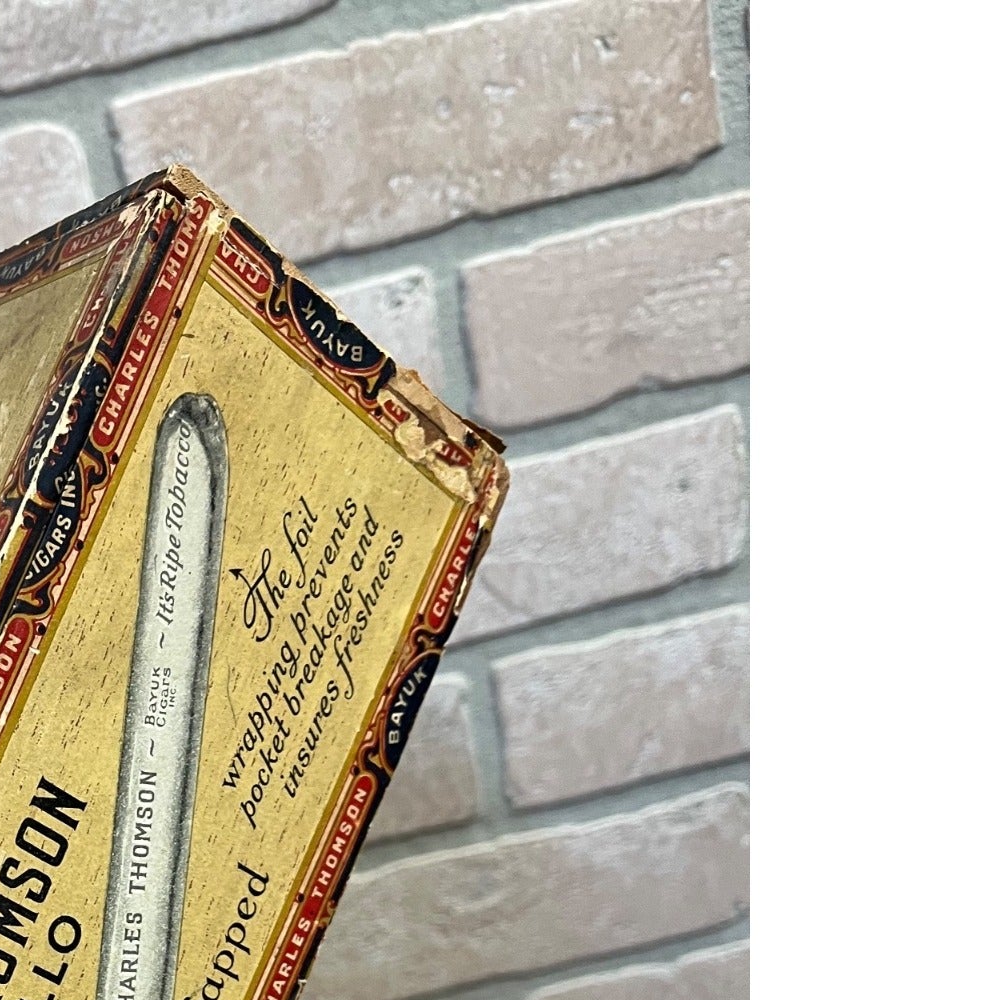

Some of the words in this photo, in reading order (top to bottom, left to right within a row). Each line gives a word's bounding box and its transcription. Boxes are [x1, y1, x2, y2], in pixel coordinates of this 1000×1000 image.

[95, 310, 160, 434] CHARLES
[300, 299, 362, 361] BAYUK
[28, 384, 72, 469] BAYUK
[164, 425, 191, 529] Tobacco
[156, 592, 177, 625] It's
[160, 533, 184, 591] Ripe
[242, 548, 292, 641] The
[279, 496, 321, 588] foil
[221, 637, 295, 787] wrapping
[286, 496, 358, 643] prevents
[237, 721, 291, 829] pocket
[282, 575, 356, 714] breakage
[356, 504, 380, 571] and
[281, 679, 340, 797] insures
[337, 528, 404, 698] freshness
[388, 665, 429, 744] BAYUK
[126, 768, 160, 892] THOMSON
[311, 786, 369, 897] THOMSON
